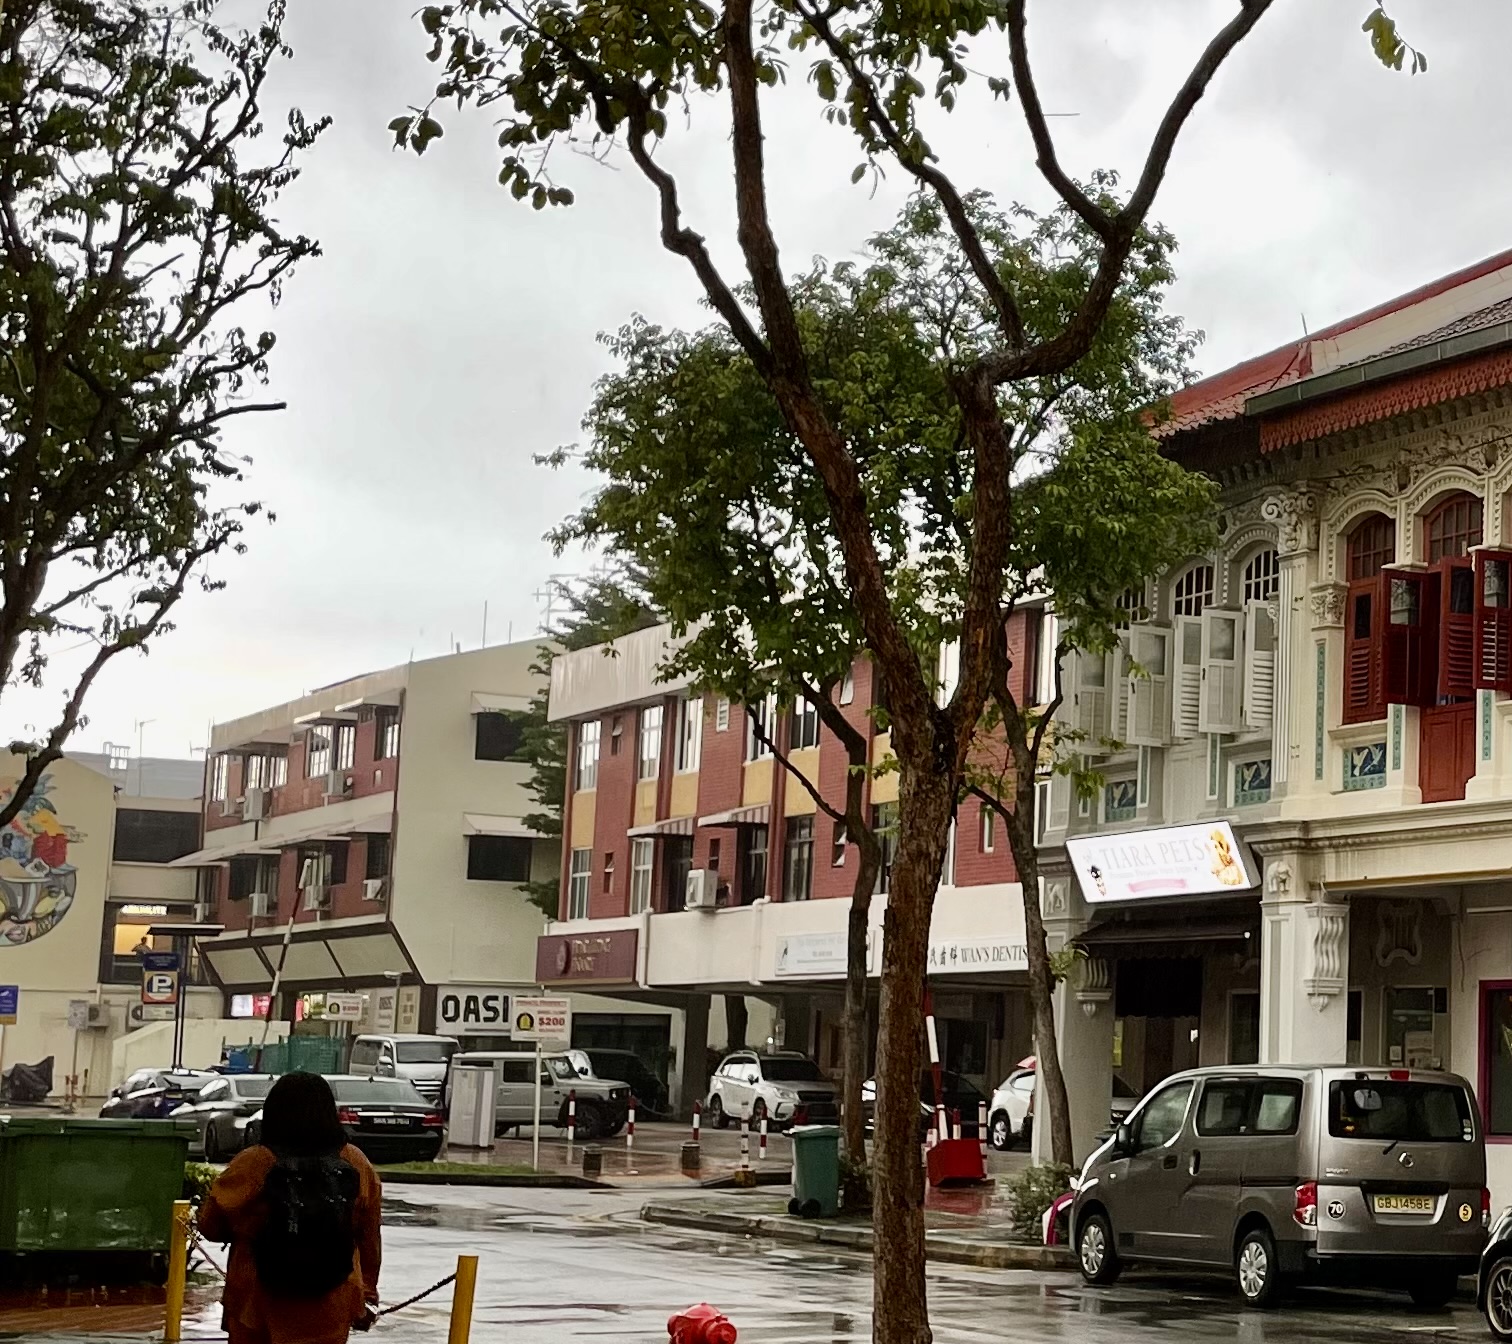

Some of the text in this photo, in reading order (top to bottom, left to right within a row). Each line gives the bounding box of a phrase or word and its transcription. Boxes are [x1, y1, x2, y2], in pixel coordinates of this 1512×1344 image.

[1098, 837, 1205, 870] TIARA PETS
[442, 994, 528, 1023] OASI
[1330, 1203, 1343, 1214] 70
[1462, 1205, 1469, 1217] 5
